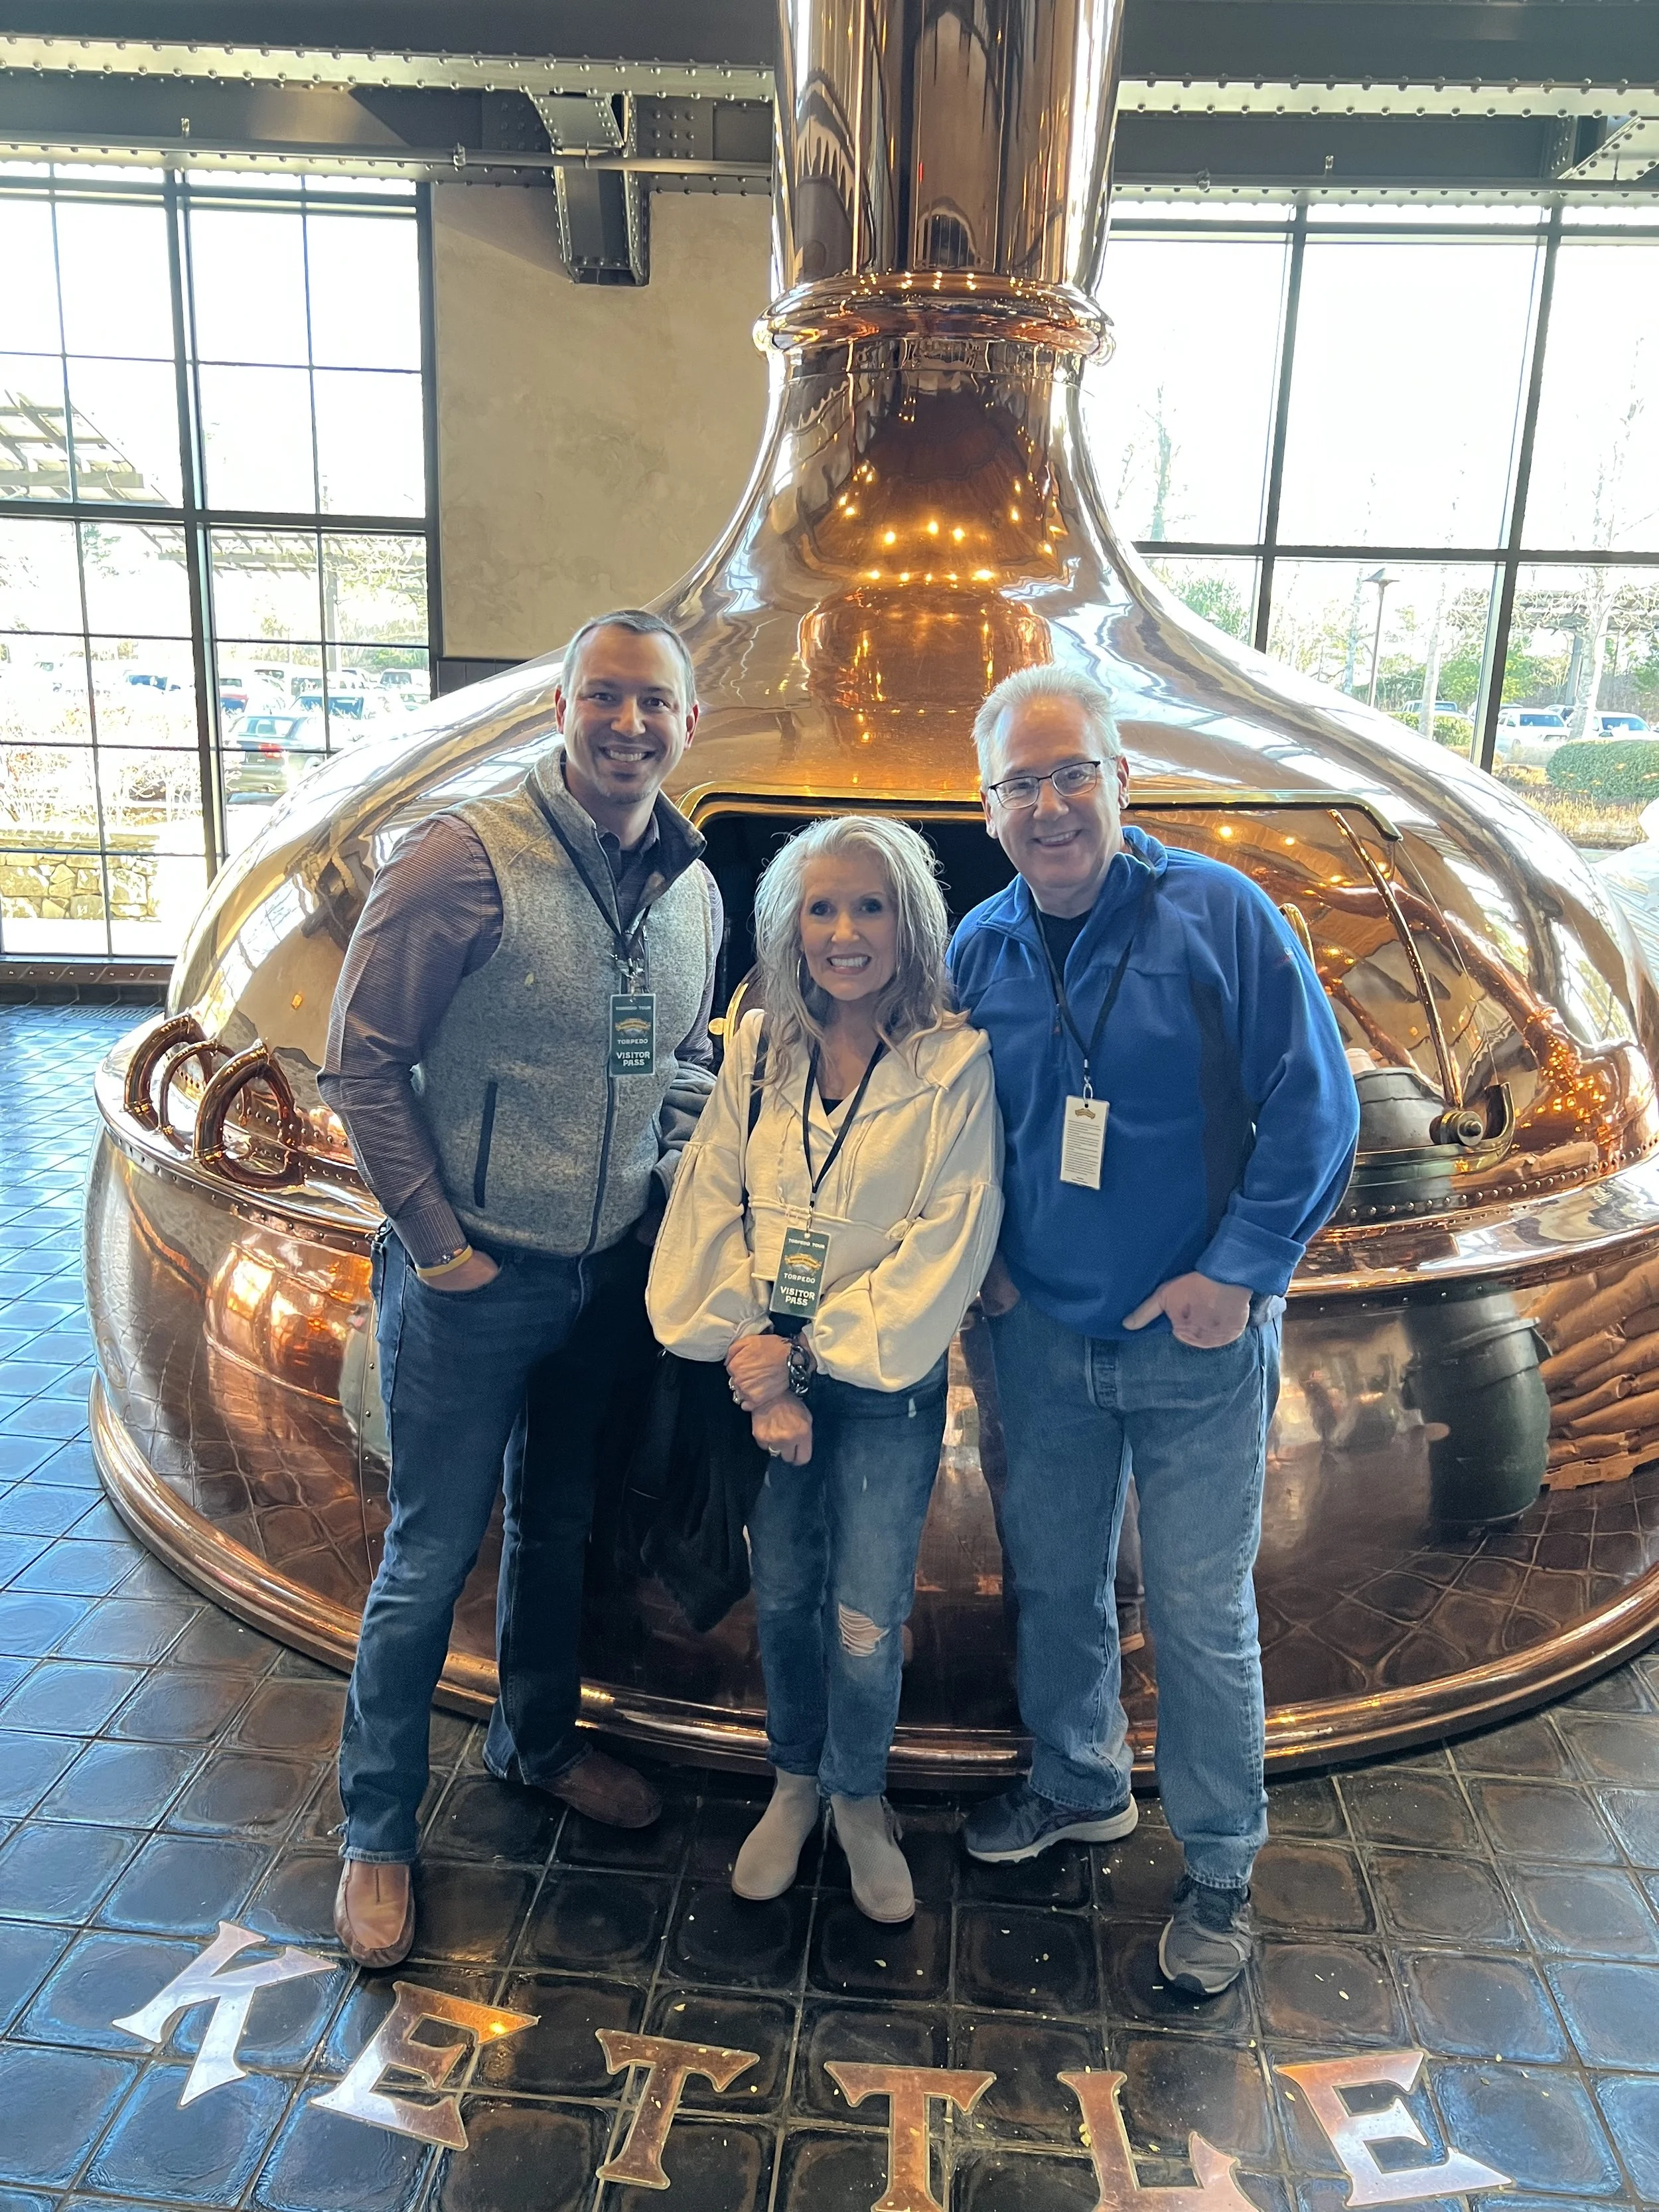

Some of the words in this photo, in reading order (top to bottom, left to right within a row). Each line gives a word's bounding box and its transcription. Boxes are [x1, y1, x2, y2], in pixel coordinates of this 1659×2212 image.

[788, 1238, 810, 1246] TORPEDO
[784, 1272, 816, 1284] TORPEDO
[780, 1286, 816, 1300] VISITOR
[785, 1295, 808, 1306] PASS
[111, 1920, 1514, 2212] KETTLE
